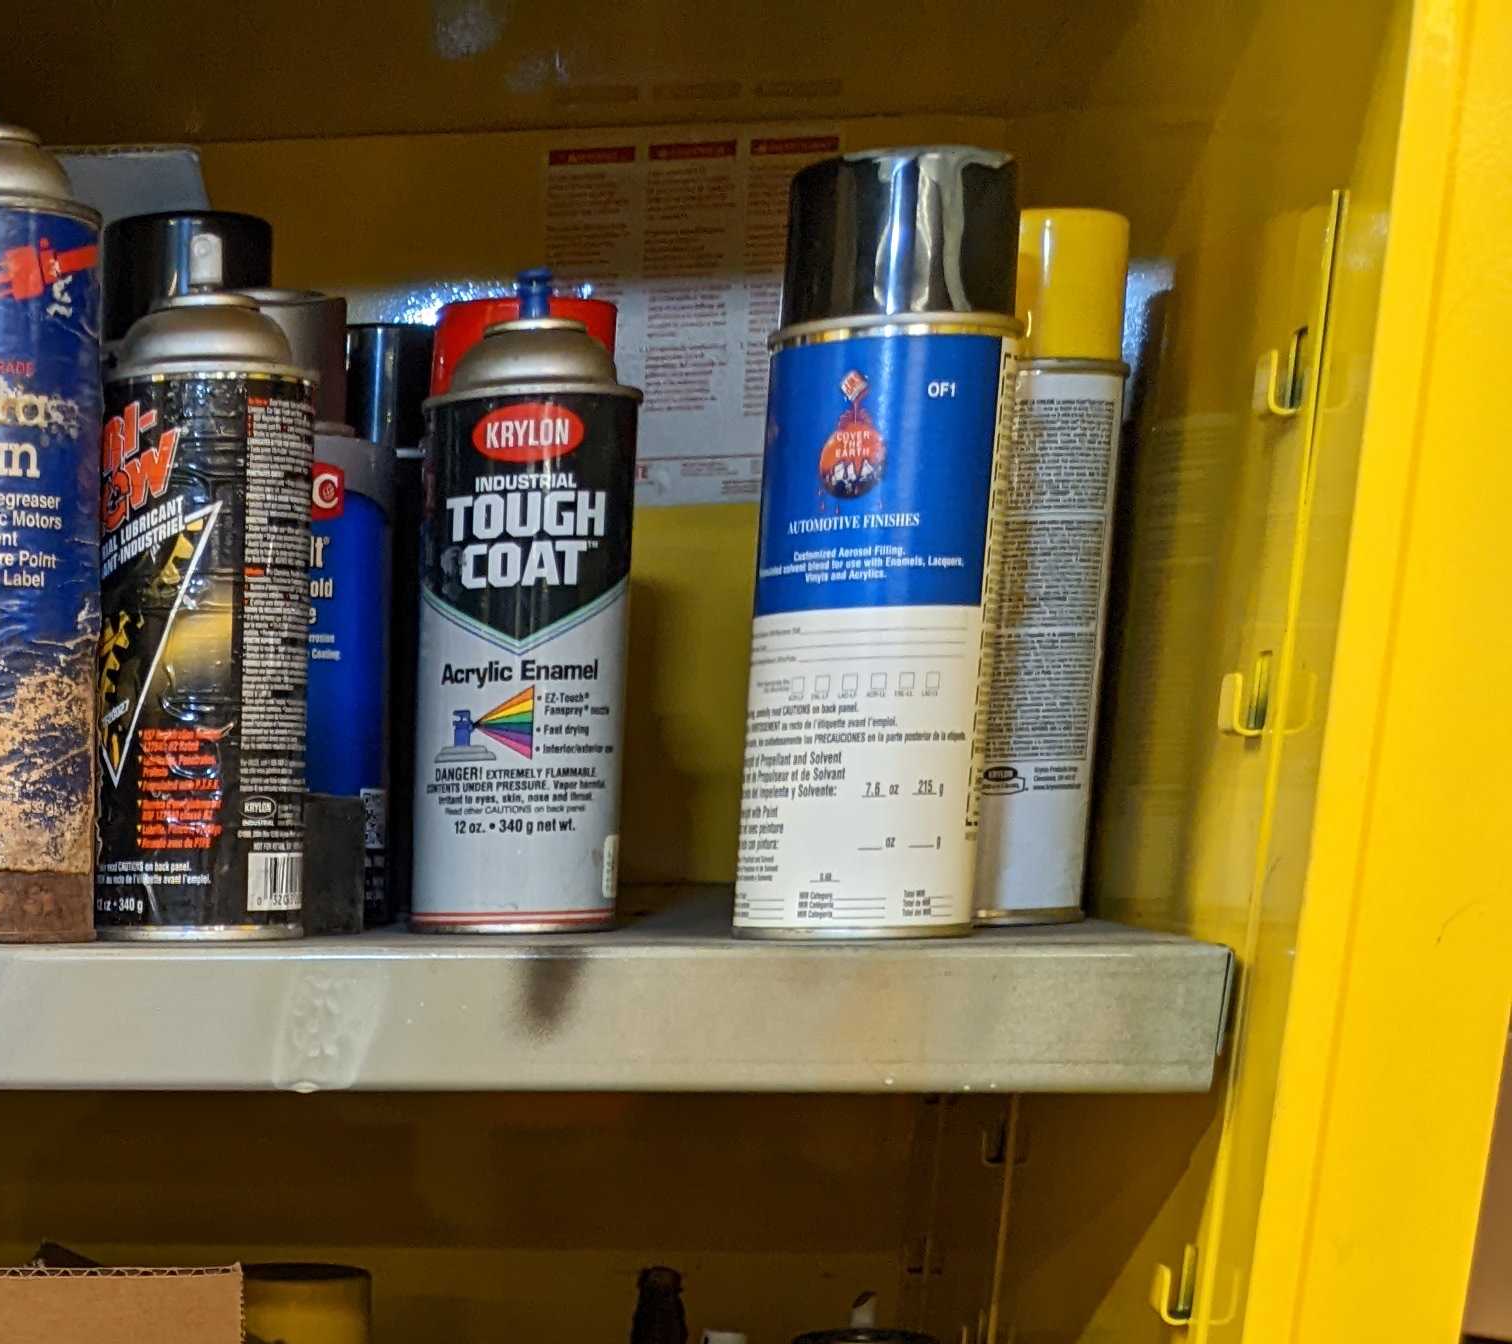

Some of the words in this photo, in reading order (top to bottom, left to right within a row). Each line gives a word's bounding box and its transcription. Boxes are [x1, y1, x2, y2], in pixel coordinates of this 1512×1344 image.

[928, 382, 956, 397] OF1
[486, 419, 569, 448] KRYLON
[836, 430, 870, 441] COVER
[843, 440, 864, 449] THE
[835, 447, 870, 458] EARTH
[475, 473, 577, 492] INDUSTRIAL
[12, 511, 62, 530] Motors
[121, 495, 184, 545] LUBRICANT
[446, 491, 606, 542] TOUGH
[788, 514, 860, 535] AUTOMOTIVE
[863, 512, 920, 528] FINISHES
[19, 551, 57, 568] Point
[838, 545, 872, 559] Aerosol
[461, 540, 588, 590] COAT
[3, 570, 45, 587] Label
[441, 661, 513, 688] Acrylic
[520, 660, 598, 682] Enamel
[544, 724, 562, 735] Fast
[564, 724, 590, 737] drying
[810, 751, 841, 765] Solvent
[435, 766, 483, 782] DANGER!
[486, 768, 542, 780] EXTREMELY
[813, 767, 845, 781] Solvant
[463, 782, 493, 793] UNDER
[918, 780, 933, 794] 215
[244, 801, 271, 813] KRYLON
[454, 820, 466, 834] 12
[499, 819, 523, 833] 340
[537, 818, 557, 832] net
[559, 818, 575, 831] wt.
[119, 899, 135, 911] 340
